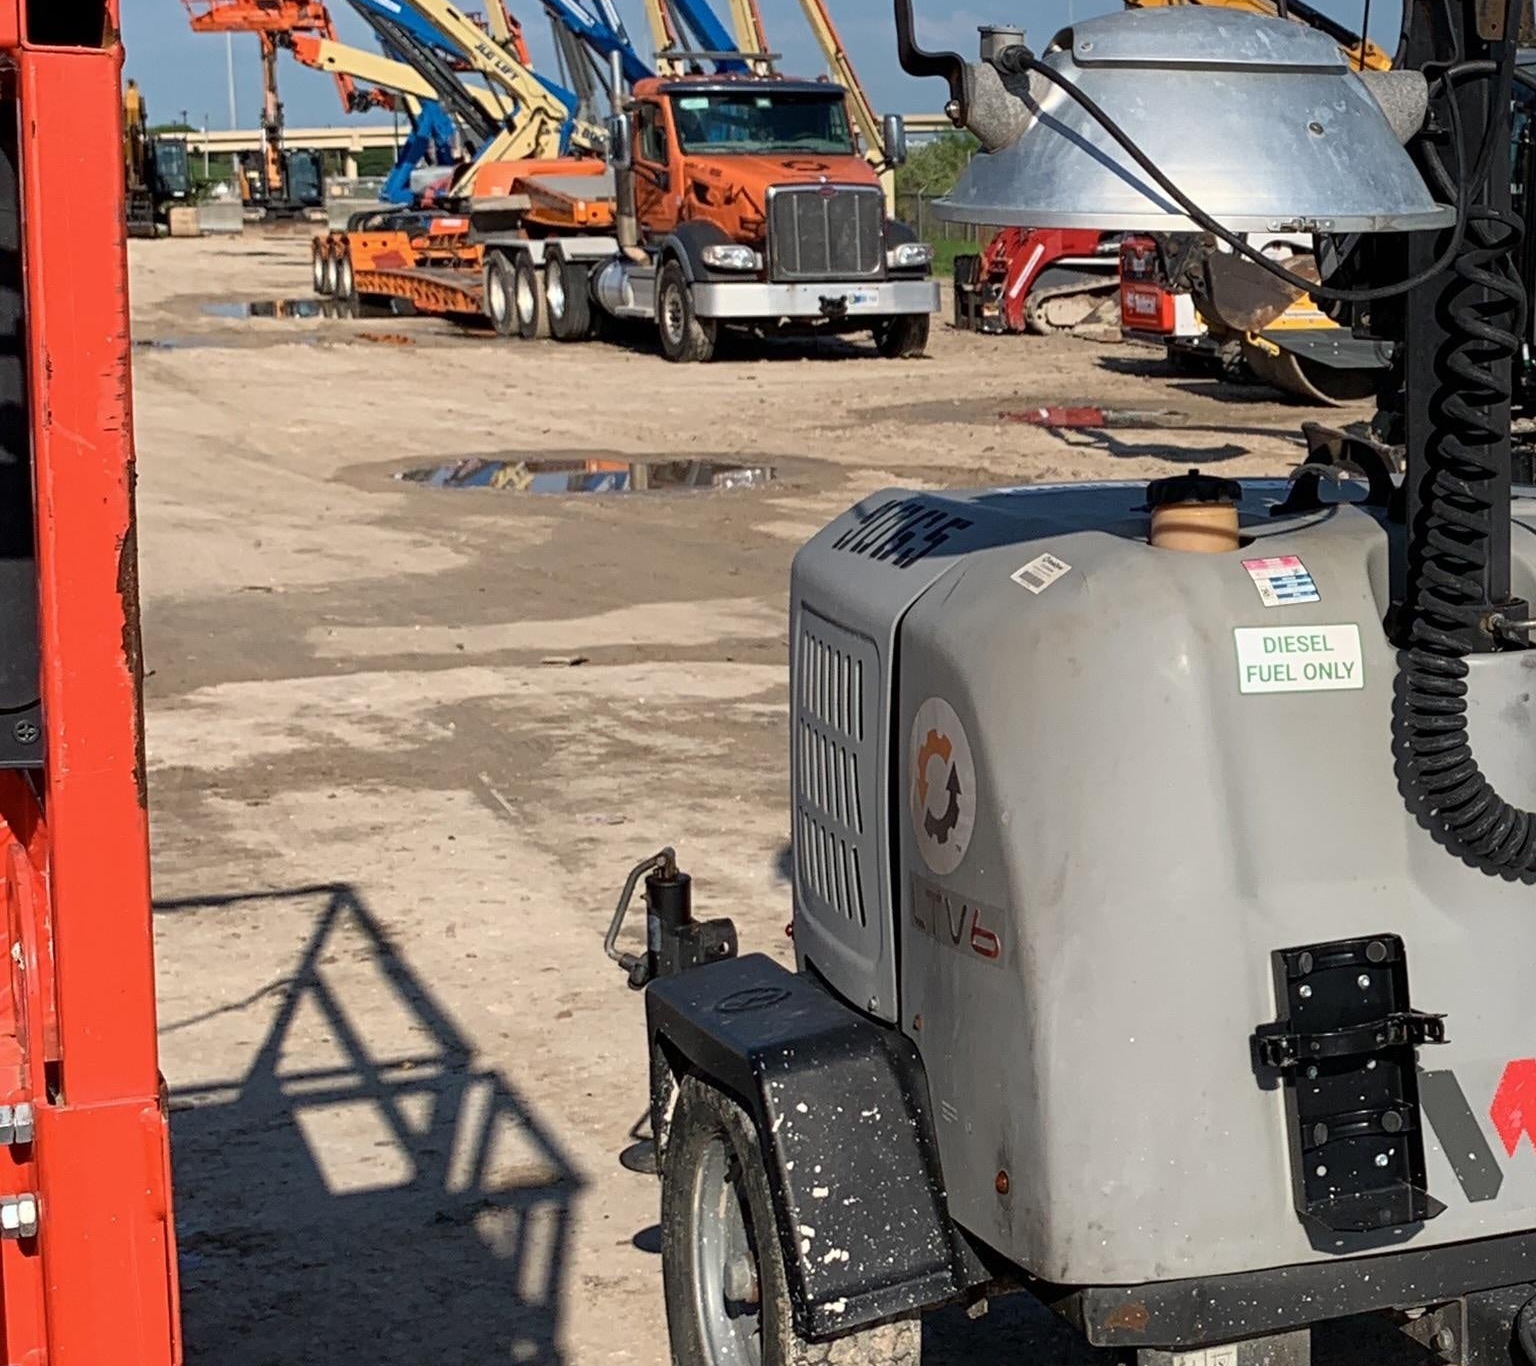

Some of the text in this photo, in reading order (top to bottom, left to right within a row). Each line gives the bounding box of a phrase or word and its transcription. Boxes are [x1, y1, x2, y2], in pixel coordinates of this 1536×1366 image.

[1263, 635, 1335, 654] DIESEL
[1246, 661, 1355, 683] FUEL ONLY
